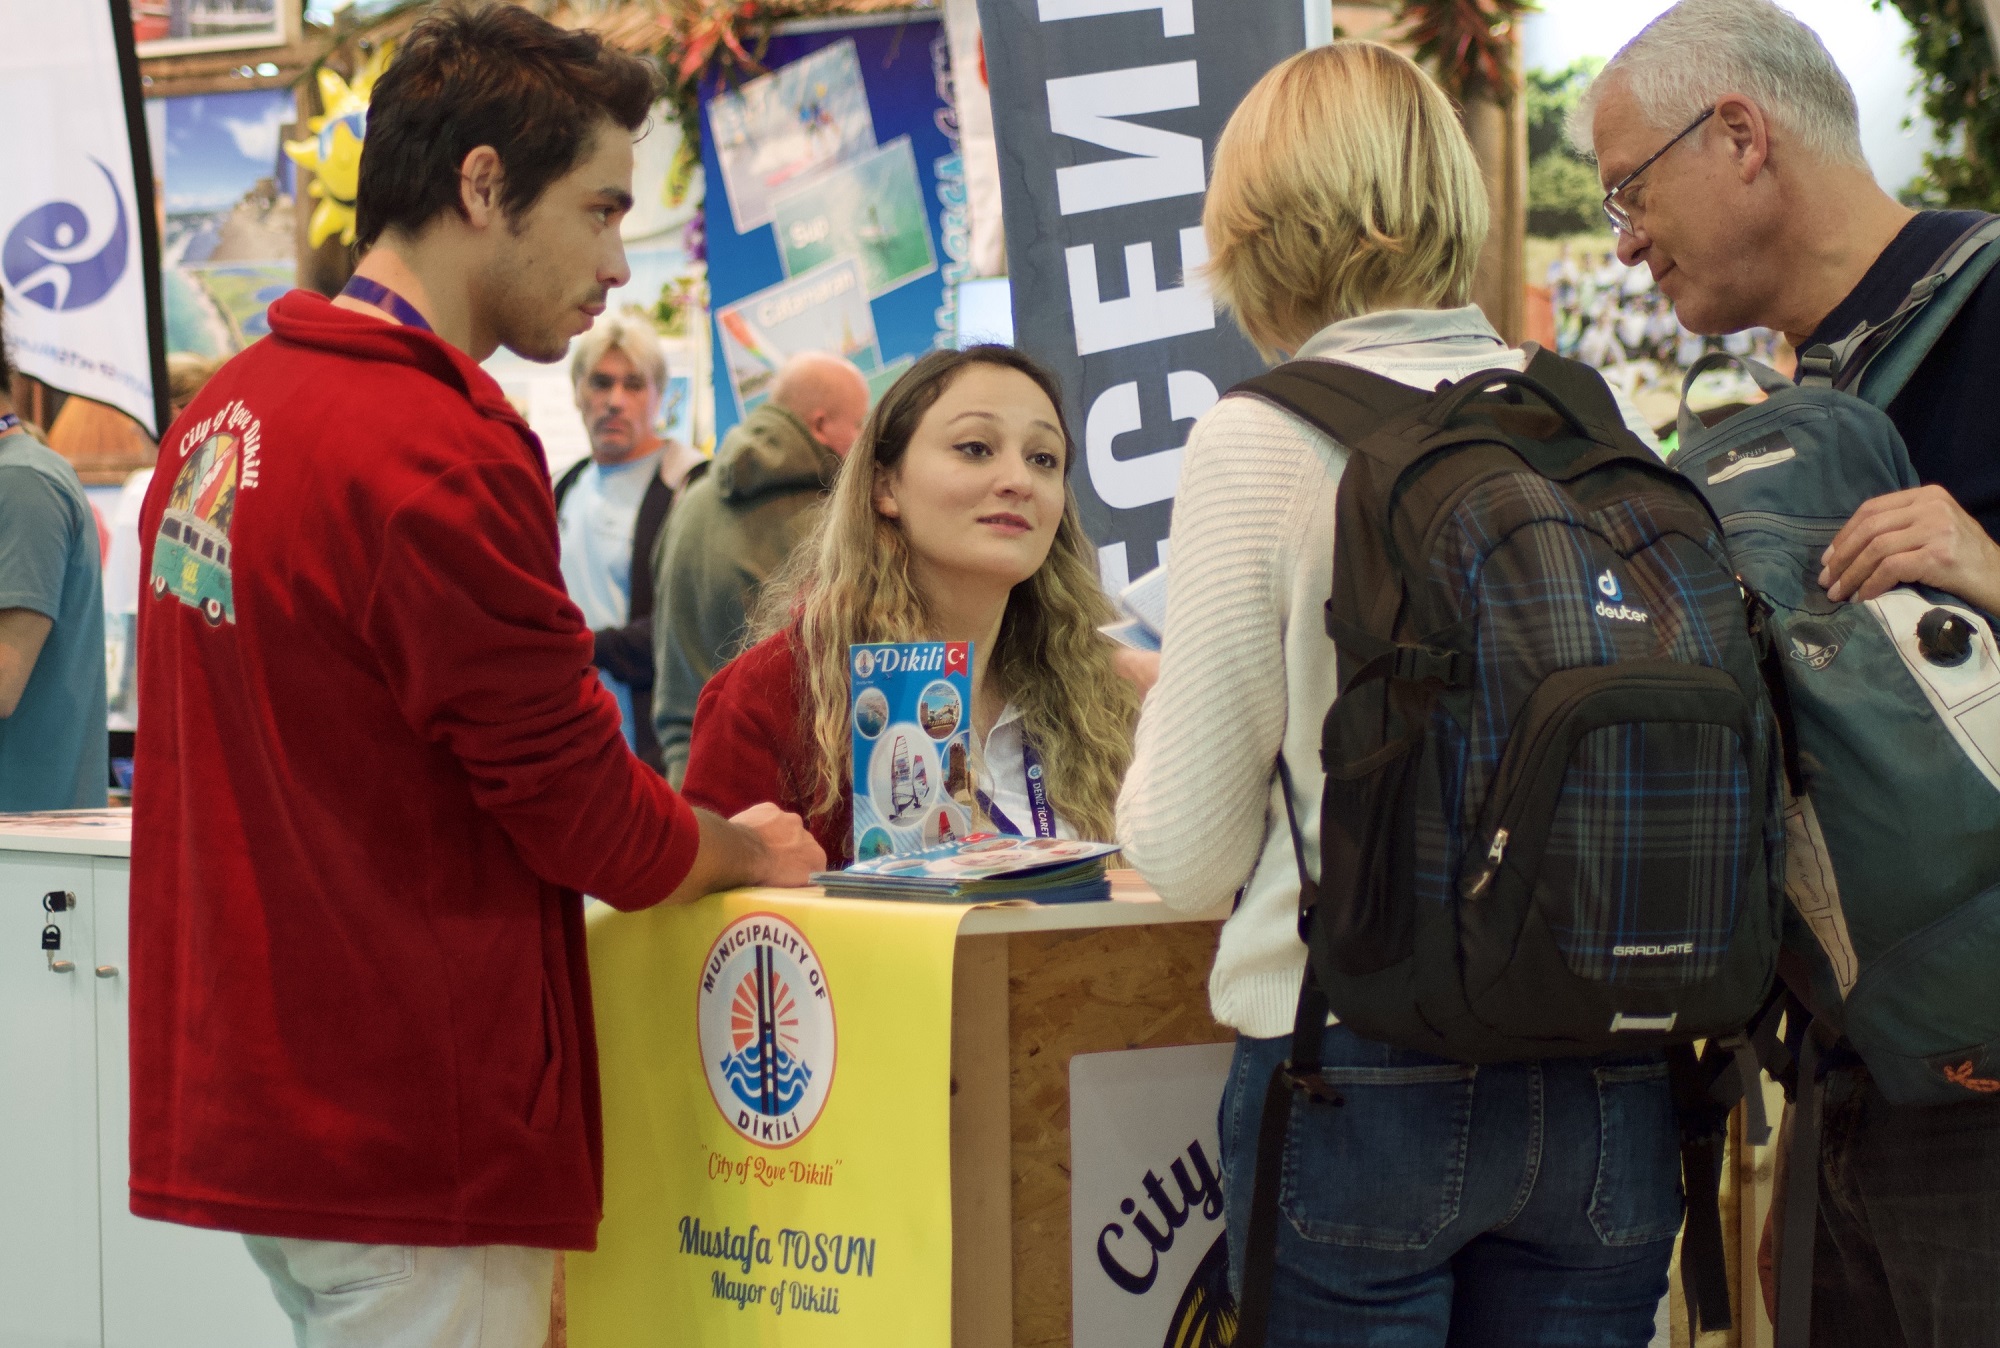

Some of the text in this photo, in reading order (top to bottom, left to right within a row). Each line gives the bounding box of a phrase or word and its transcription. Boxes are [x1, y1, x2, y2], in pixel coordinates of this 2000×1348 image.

[180, 417, 212, 457] City
[213, 401, 234, 432] of
[240, 420, 261, 490] Dikili
[1595, 600, 1648, 623] deuter
[875, 647, 944, 673] Dikili
[703, 924, 826, 999] MUNICIPALITY OF
[1612, 943, 1693, 956] GRADUATE
[737, 1110, 801, 1142] DİKİLİ
[735, 1155, 754, 1185] of
[1097, 1138, 1225, 1295] City
[678, 1215, 876, 1278] Mustafa TOSUN
[711, 1269, 840, 1316] Mayor of Dikili
